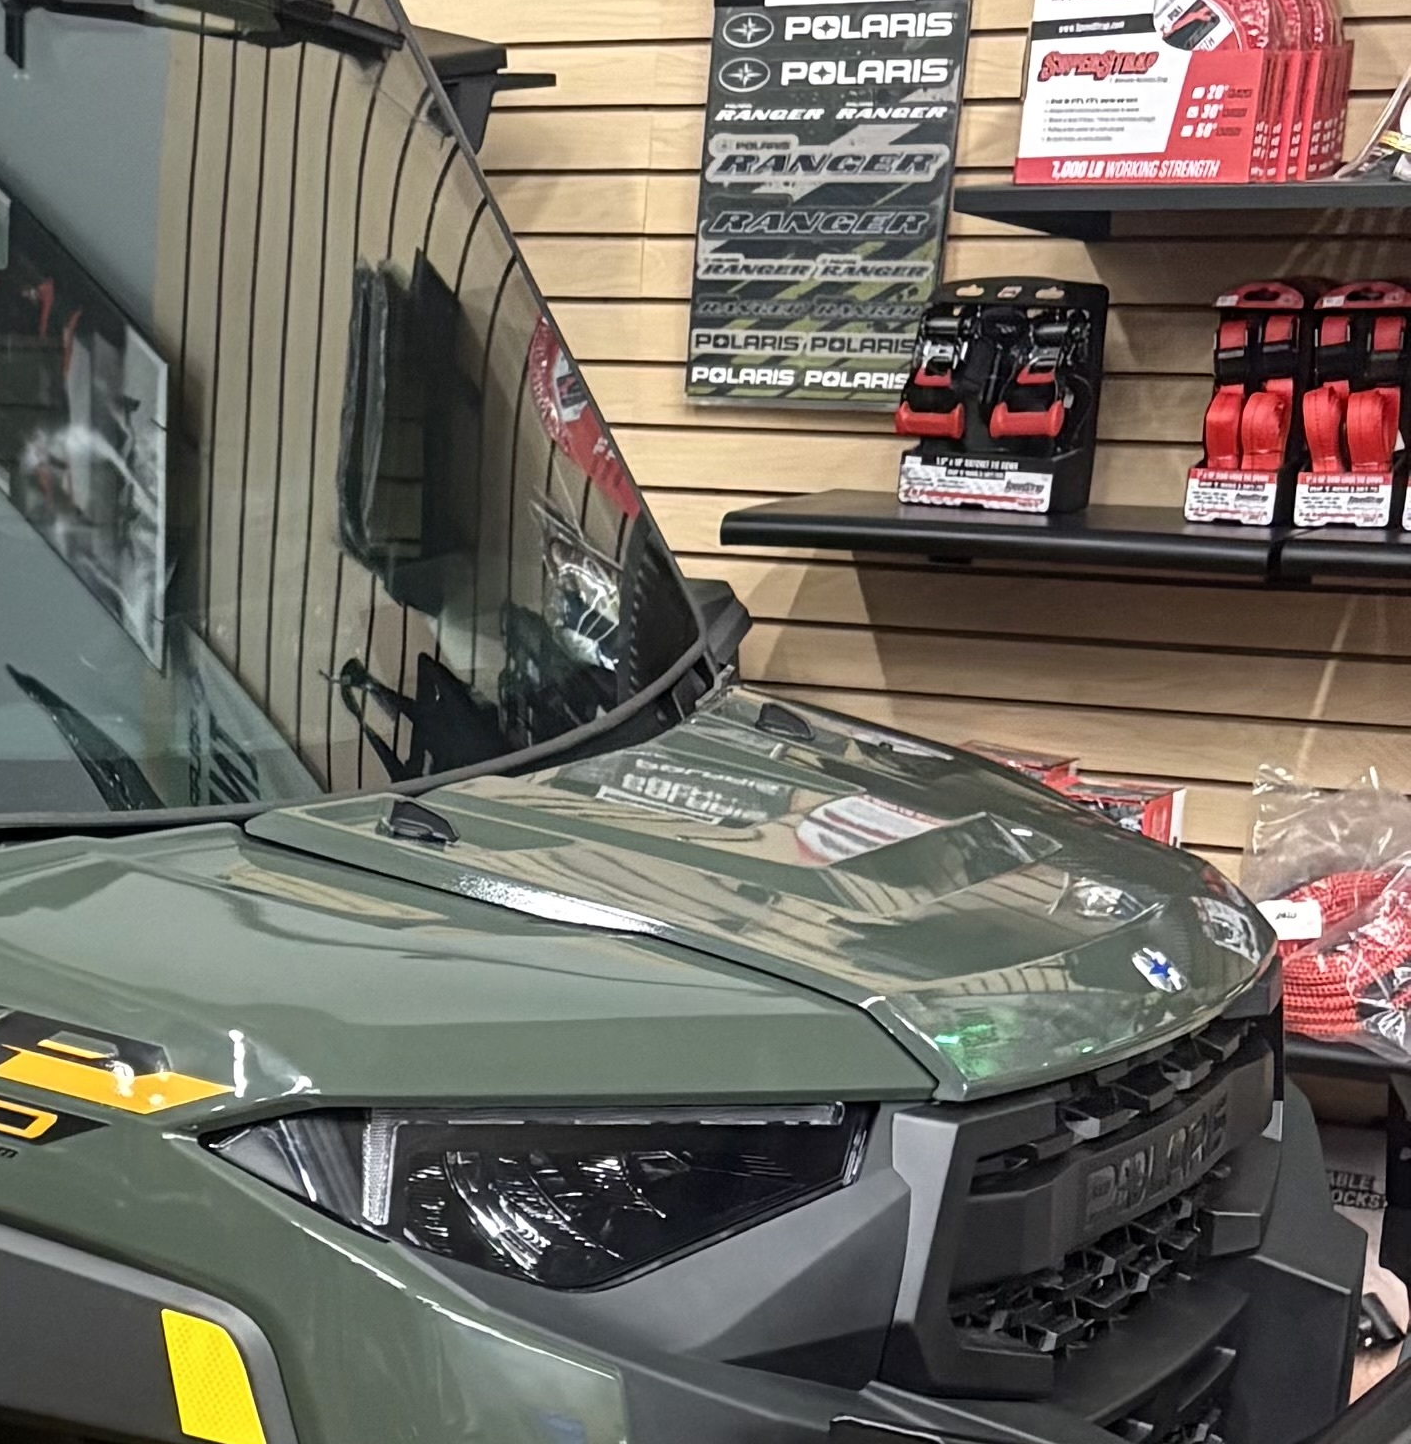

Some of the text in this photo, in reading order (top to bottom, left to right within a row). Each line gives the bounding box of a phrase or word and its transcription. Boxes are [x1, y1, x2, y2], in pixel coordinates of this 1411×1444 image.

[784, 12, 954, 40] POLARIS
[781, 58, 949, 86] POLARIS
[715, 107, 825, 121] RANGER
[835, 106, 948, 120] RANGER
[736, 141, 790, 151] POLARIS
[714, 153, 935, 176] RANGER
[1088, 161, 1106, 179] LB
[1105, 160, 1160, 178] WORKING
[1160, 160, 1220, 178] STRENGTH
[709, 211, 929, 234] RANGER
[702, 263, 814, 276] RANGER
[819, 264, 929, 277] RANGER
[695, 333, 800, 352] POLARIS
[810, 335, 915, 354] POLARIS
[691, 367, 795, 386] POLARIS
[804, 369, 911, 390] POLARIS
